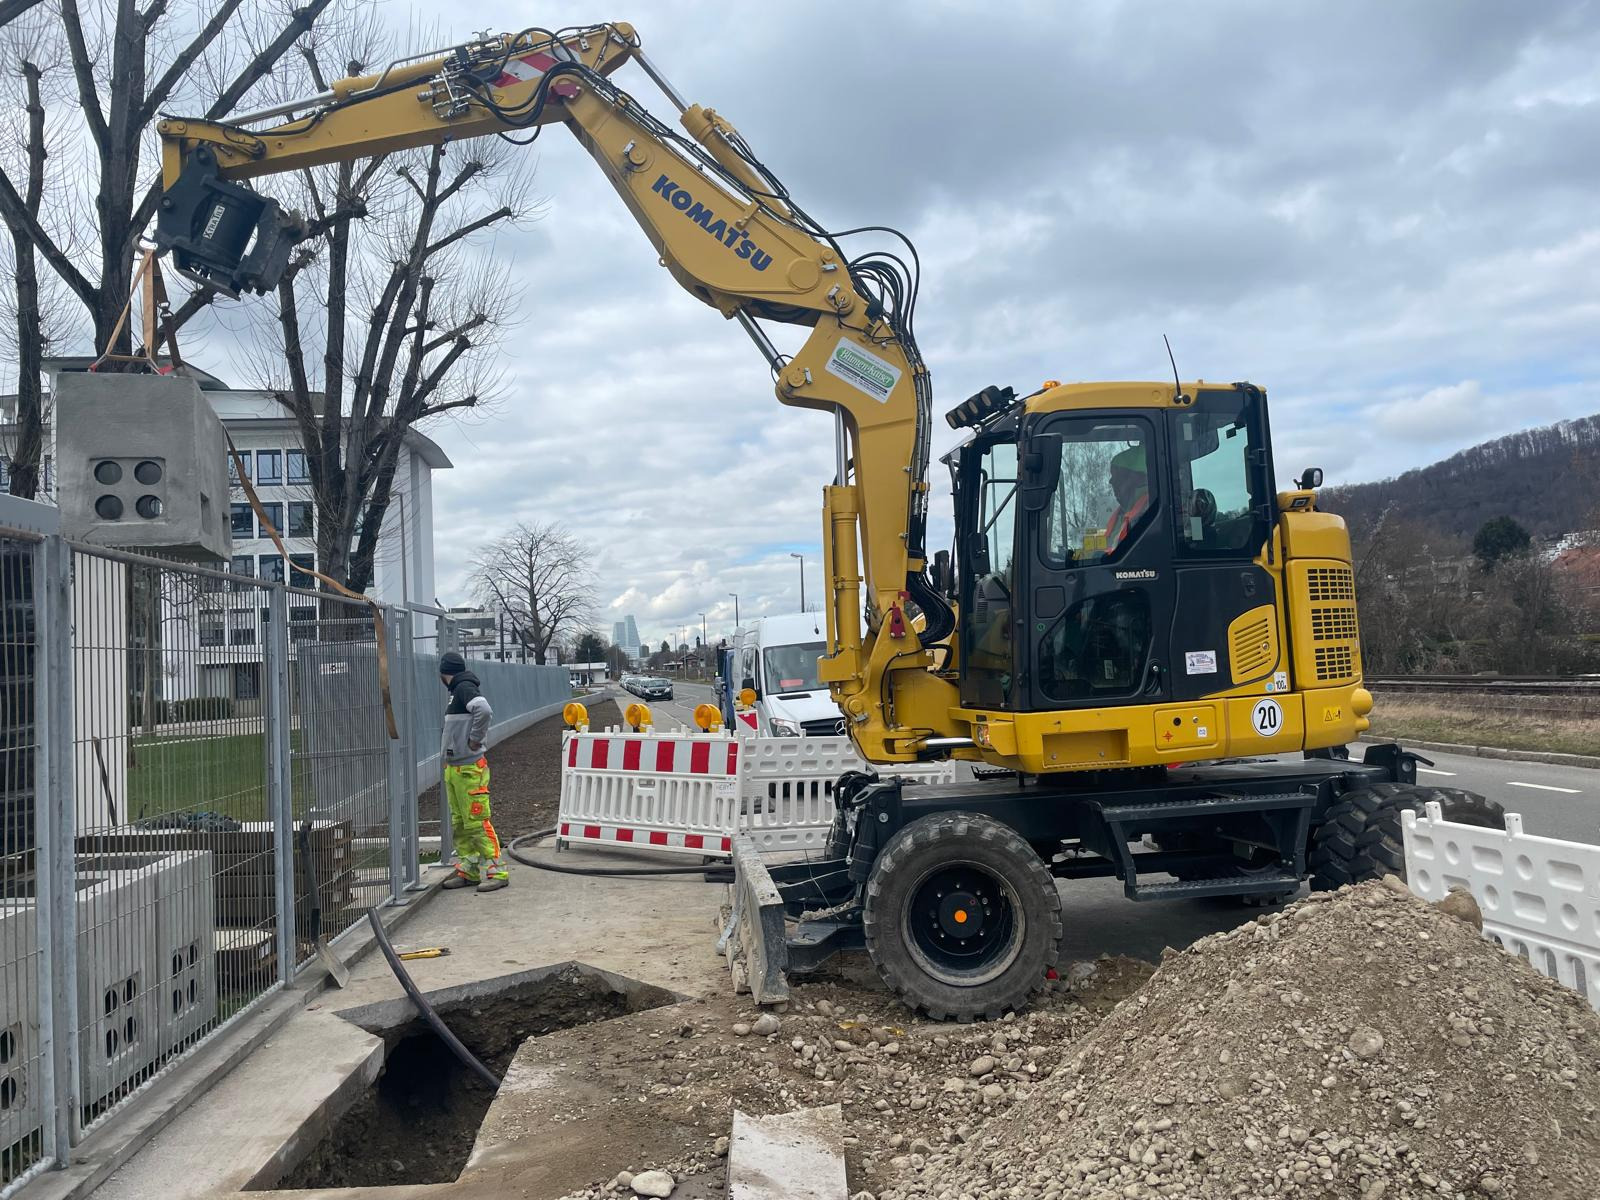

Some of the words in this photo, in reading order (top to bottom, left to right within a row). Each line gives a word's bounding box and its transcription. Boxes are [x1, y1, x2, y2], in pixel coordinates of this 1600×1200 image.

[652, 174, 773, 272] KOMATSU
[1115, 569, 1156, 579] KOMATSU
[1258, 705, 1277, 730] 20
